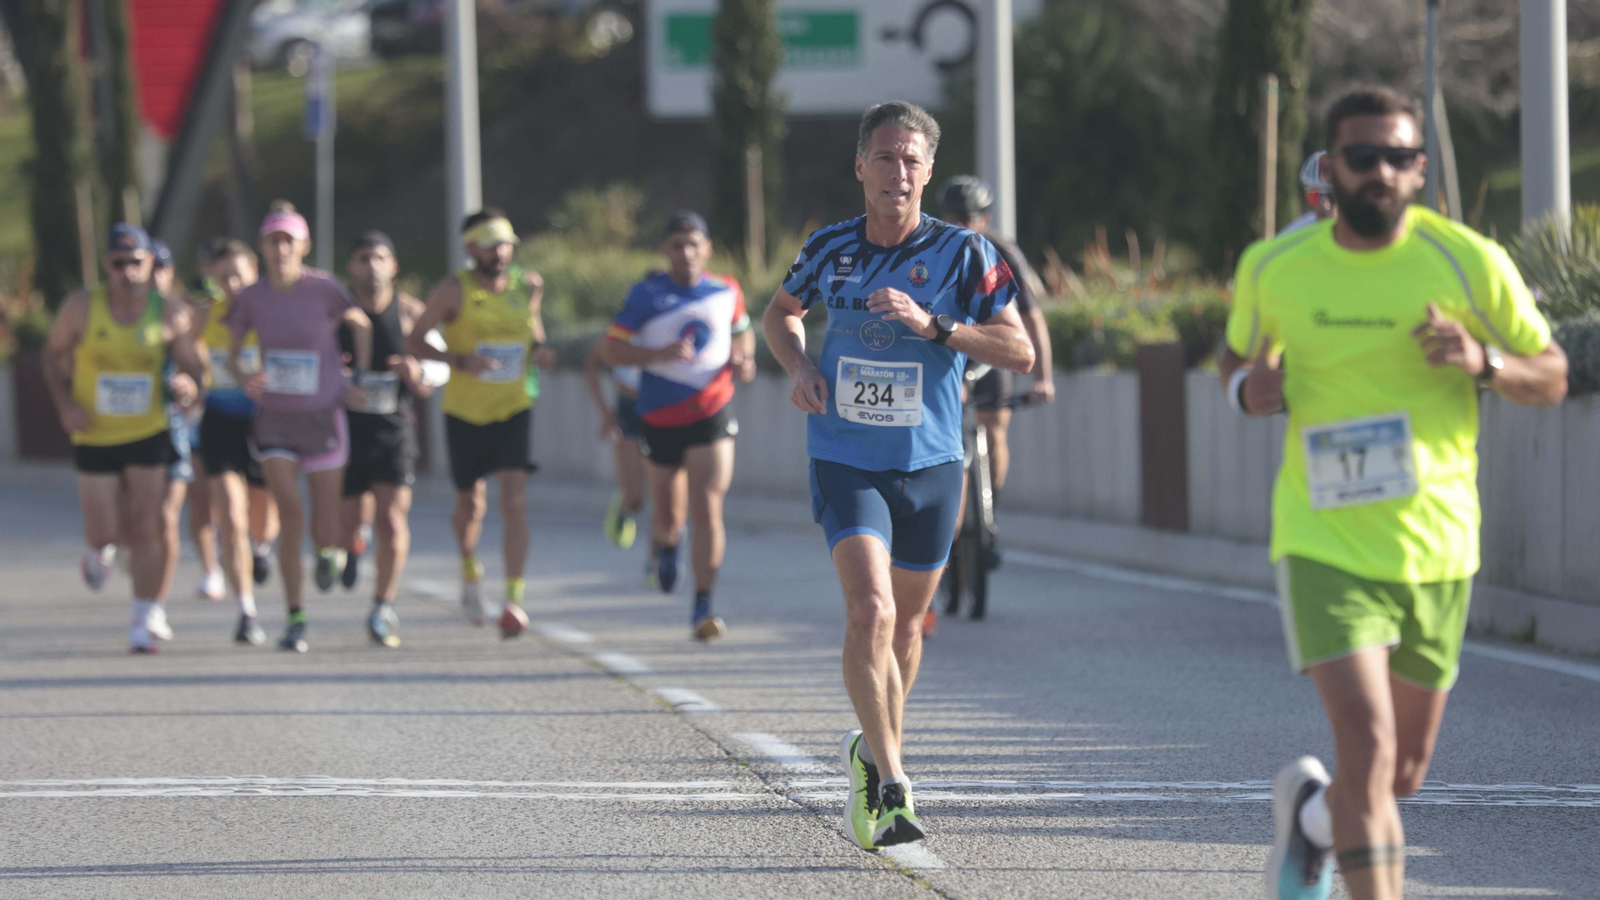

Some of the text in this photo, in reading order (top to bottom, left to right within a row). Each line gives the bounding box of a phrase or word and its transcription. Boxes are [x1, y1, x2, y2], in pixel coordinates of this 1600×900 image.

[827, 296, 849, 309] C.D.
[860, 369, 894, 378] MARATÓN
[854, 381, 894, 407] 234
[857, 411, 894, 422] EVOS
[1339, 448, 1368, 481] 17
